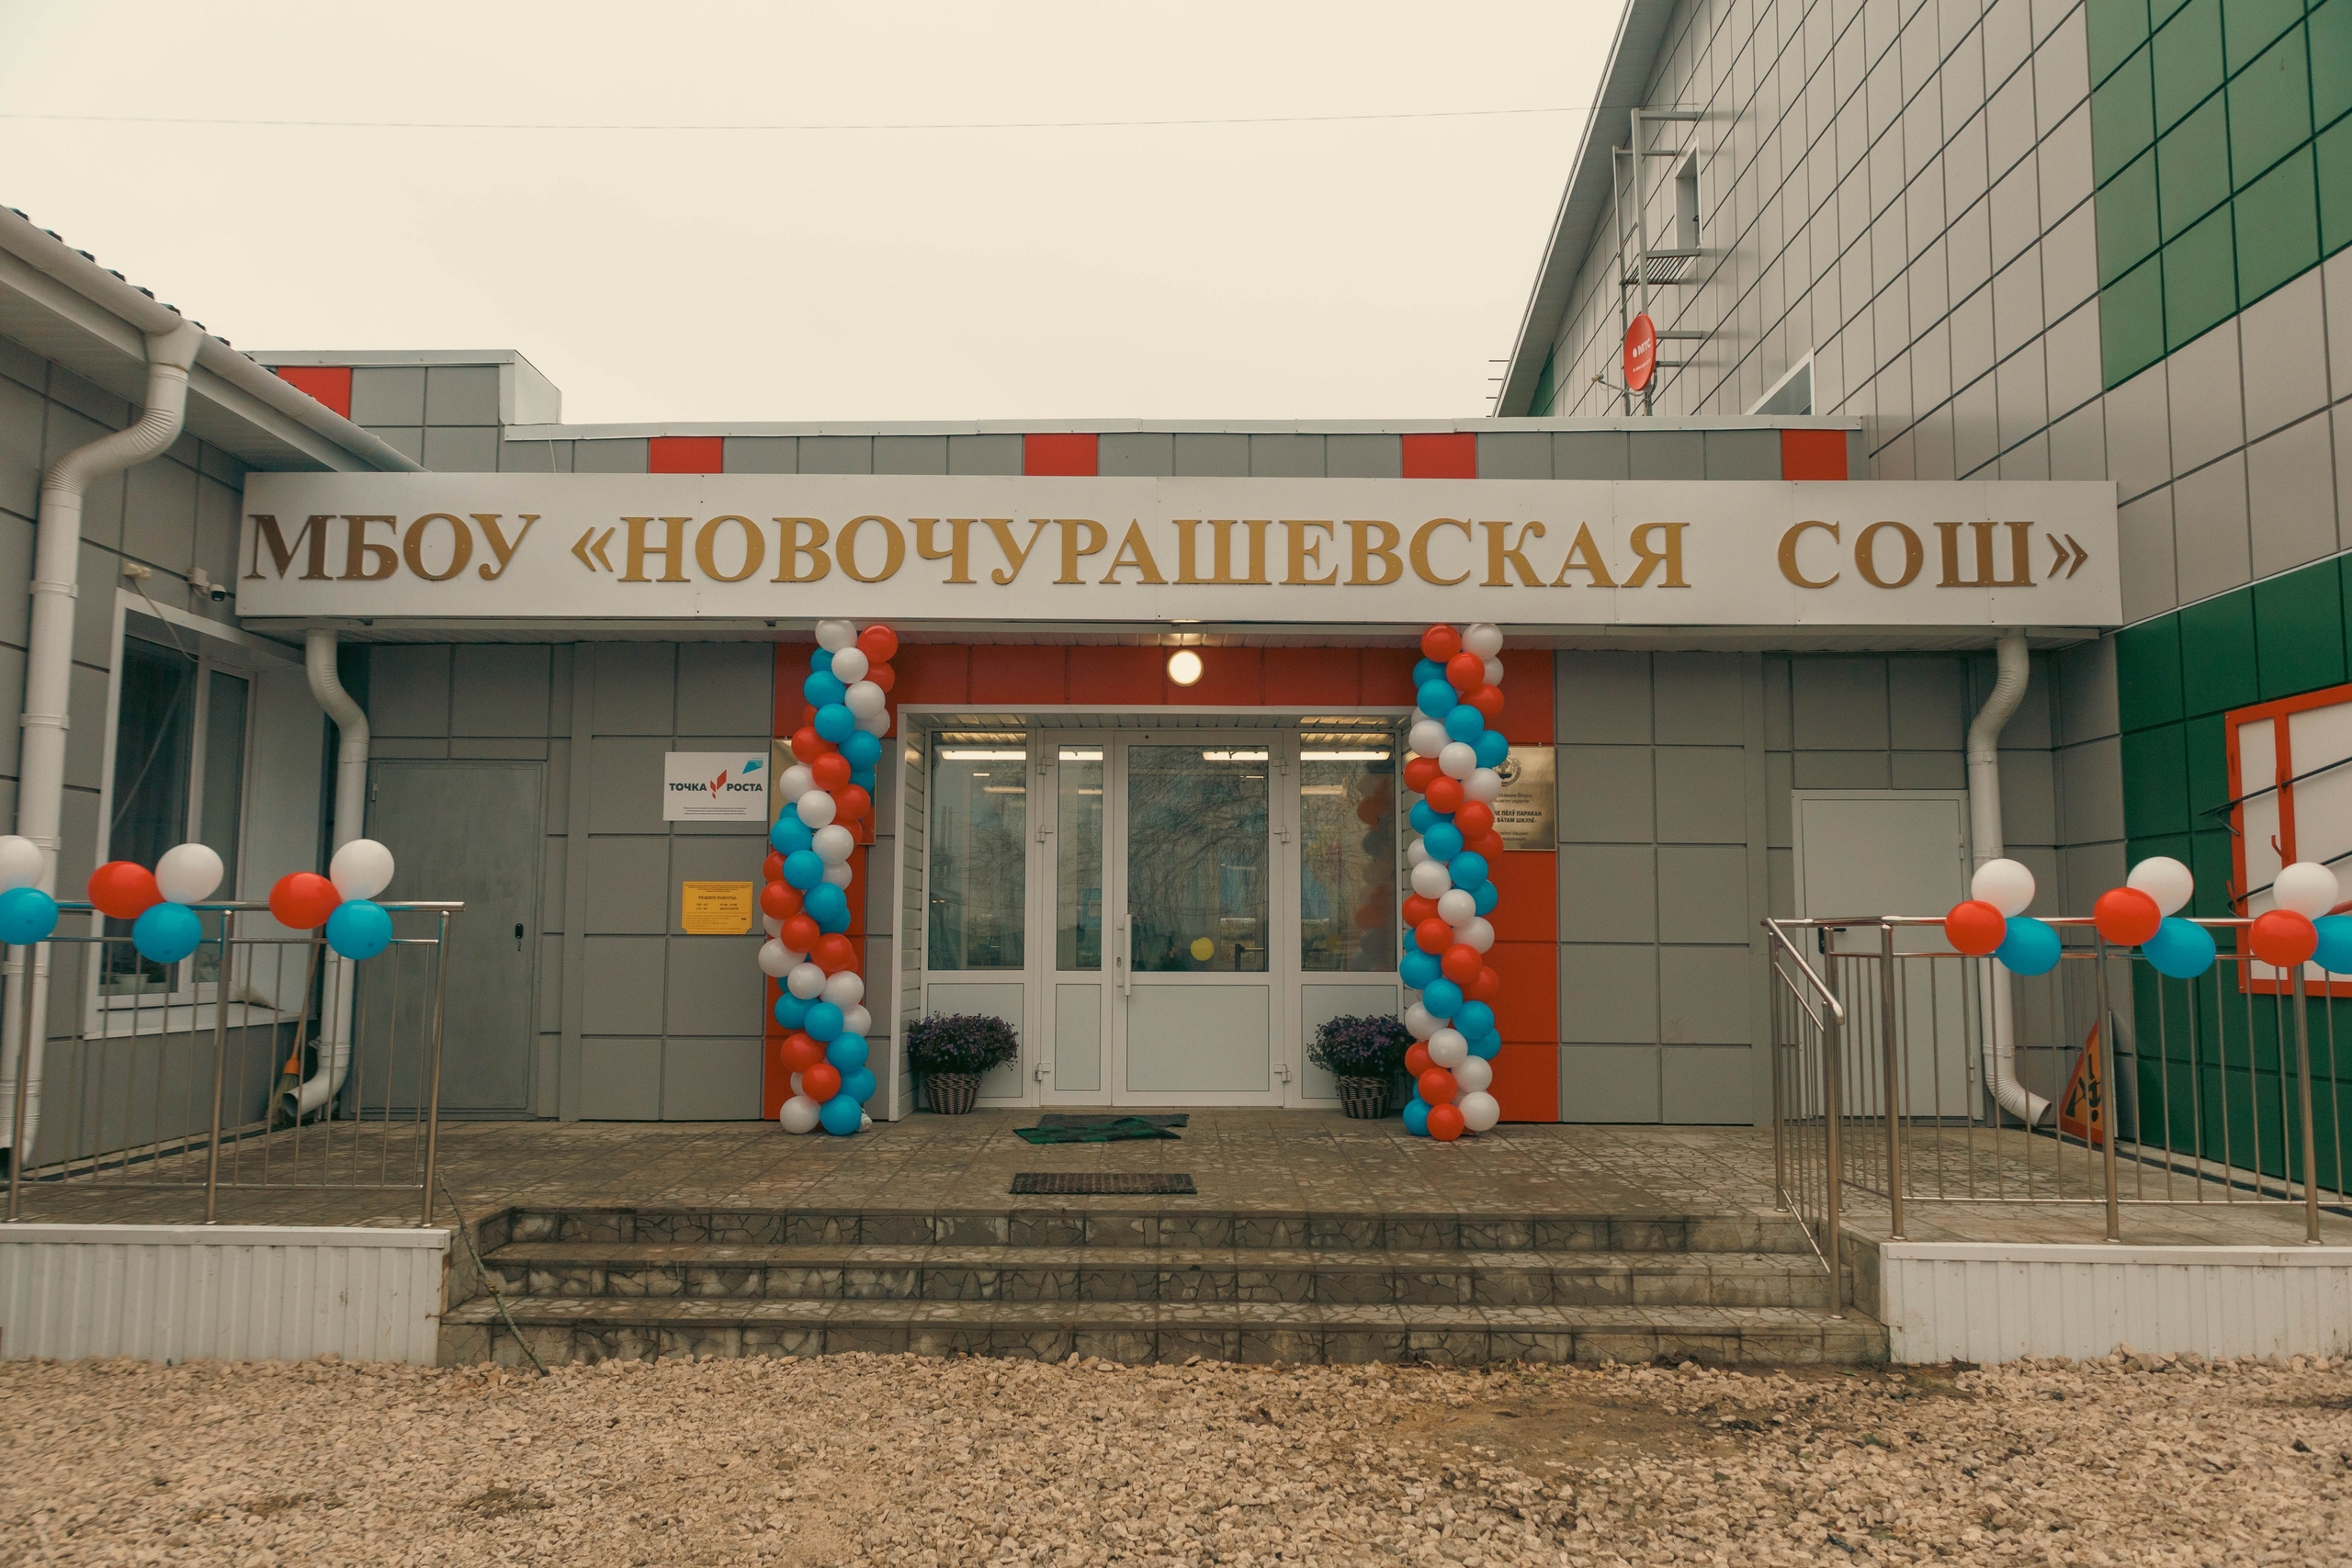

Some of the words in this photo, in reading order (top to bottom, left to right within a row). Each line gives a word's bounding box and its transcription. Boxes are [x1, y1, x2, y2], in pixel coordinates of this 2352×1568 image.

[1637, 337, 1651, 355] МТС
[243, 513, 541, 581] МБОУ
[571, 514, 1691, 588] «НОВОЧУРАШЕВСКАЯ
[1777, 520, 2087, 589] СОШ»
[669, 783, 707, 792] ТОЧКА
[726, 783, 763, 792] РОСТА
